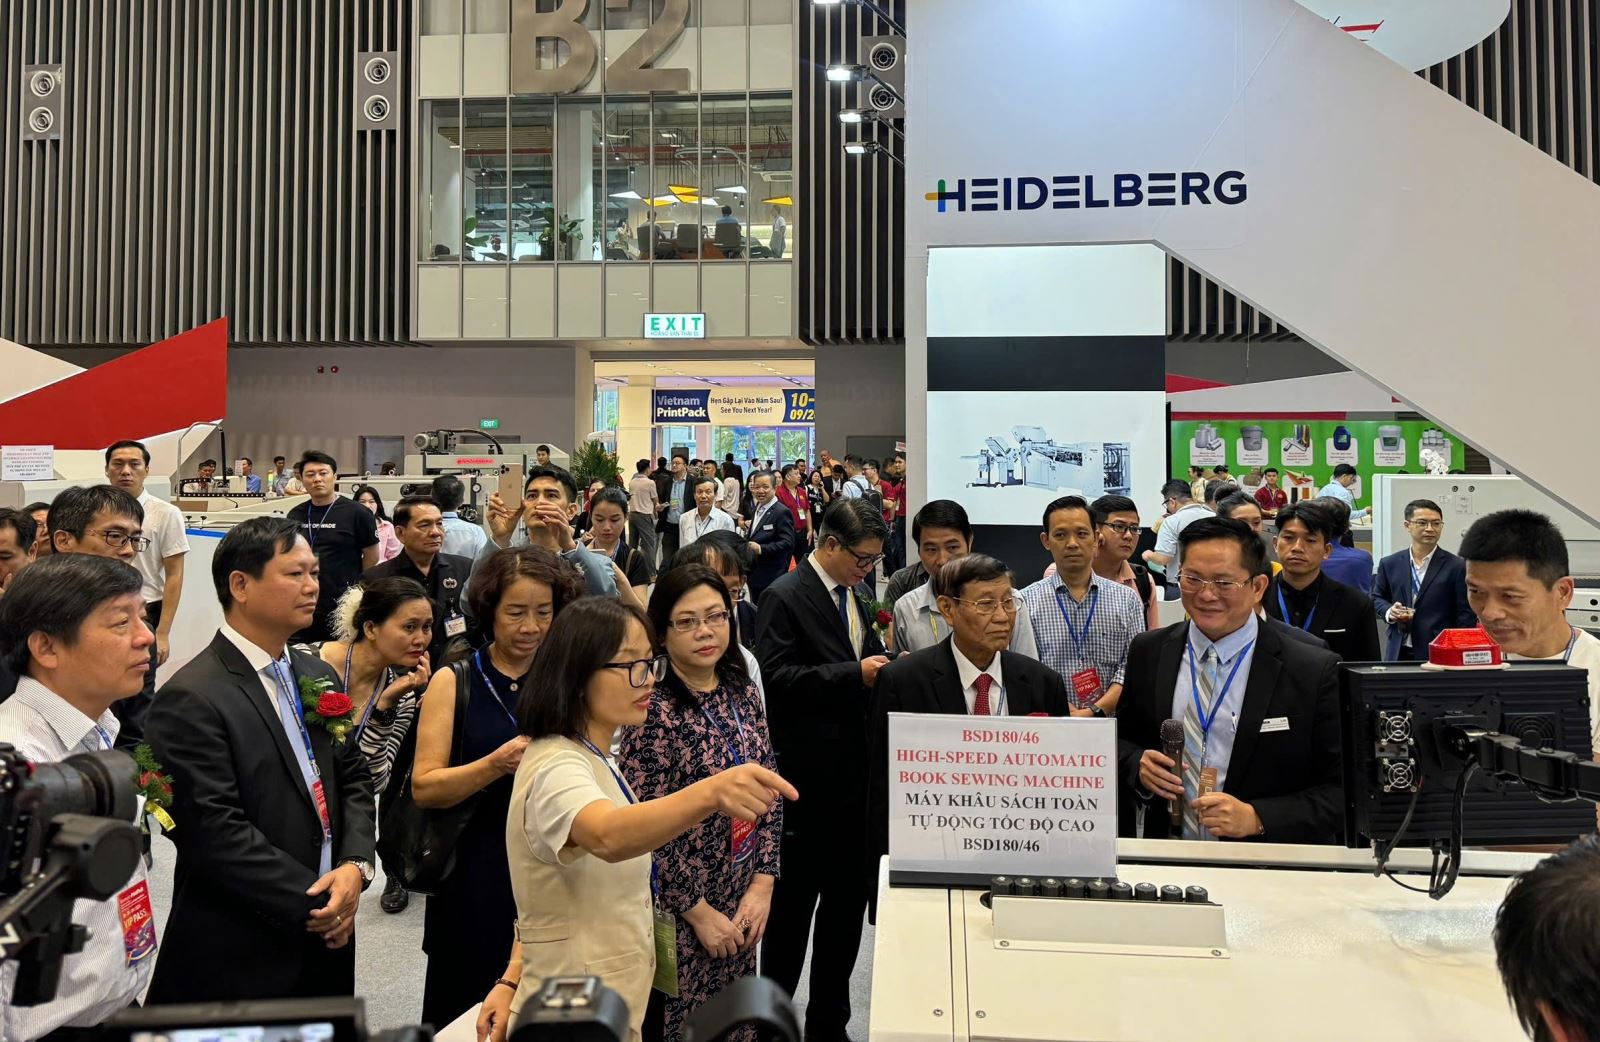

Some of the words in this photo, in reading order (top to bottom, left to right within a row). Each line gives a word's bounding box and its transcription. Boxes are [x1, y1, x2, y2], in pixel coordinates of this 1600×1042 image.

[511, 0, 692, 94] B2
[925, 170, 1248, 213] HEIDELBERG
[650, 317, 702, 331] EXIT
[657, 395, 700, 406] Vietnam
[656, 406, 706, 417] PrintPack
[720, 406, 732, 414] See
[732, 406, 743, 414] You
[743, 406, 757, 414] Next
[757, 406, 773, 414] Year!
[790, 408, 815, 421] 09/2
[962, 729, 1040, 744] BSD180/46
[896, 749, 998, 765] HIGH-SPEED
[1003, 753, 1107, 768] AUTOMATIC
[899, 771, 947, 785] BOOK
[951, 773, 1018, 788] SEWING
[1023, 775, 1104, 789] MACHINE
[905, 790, 943, 806] MÁY
[948, 792, 996, 808] KHÂU
[1000, 793, 1046, 810] SÁCH
[1050, 794, 1098, 811] TOÀN
[908, 813, 933, 830] TỰ
[1029, 817, 1054, 835] ĐỘ
[1058, 819, 1095, 833] CAO
[963, 837, 1040, 853] BSD180/46
[133, 908, 147, 923] PASS
